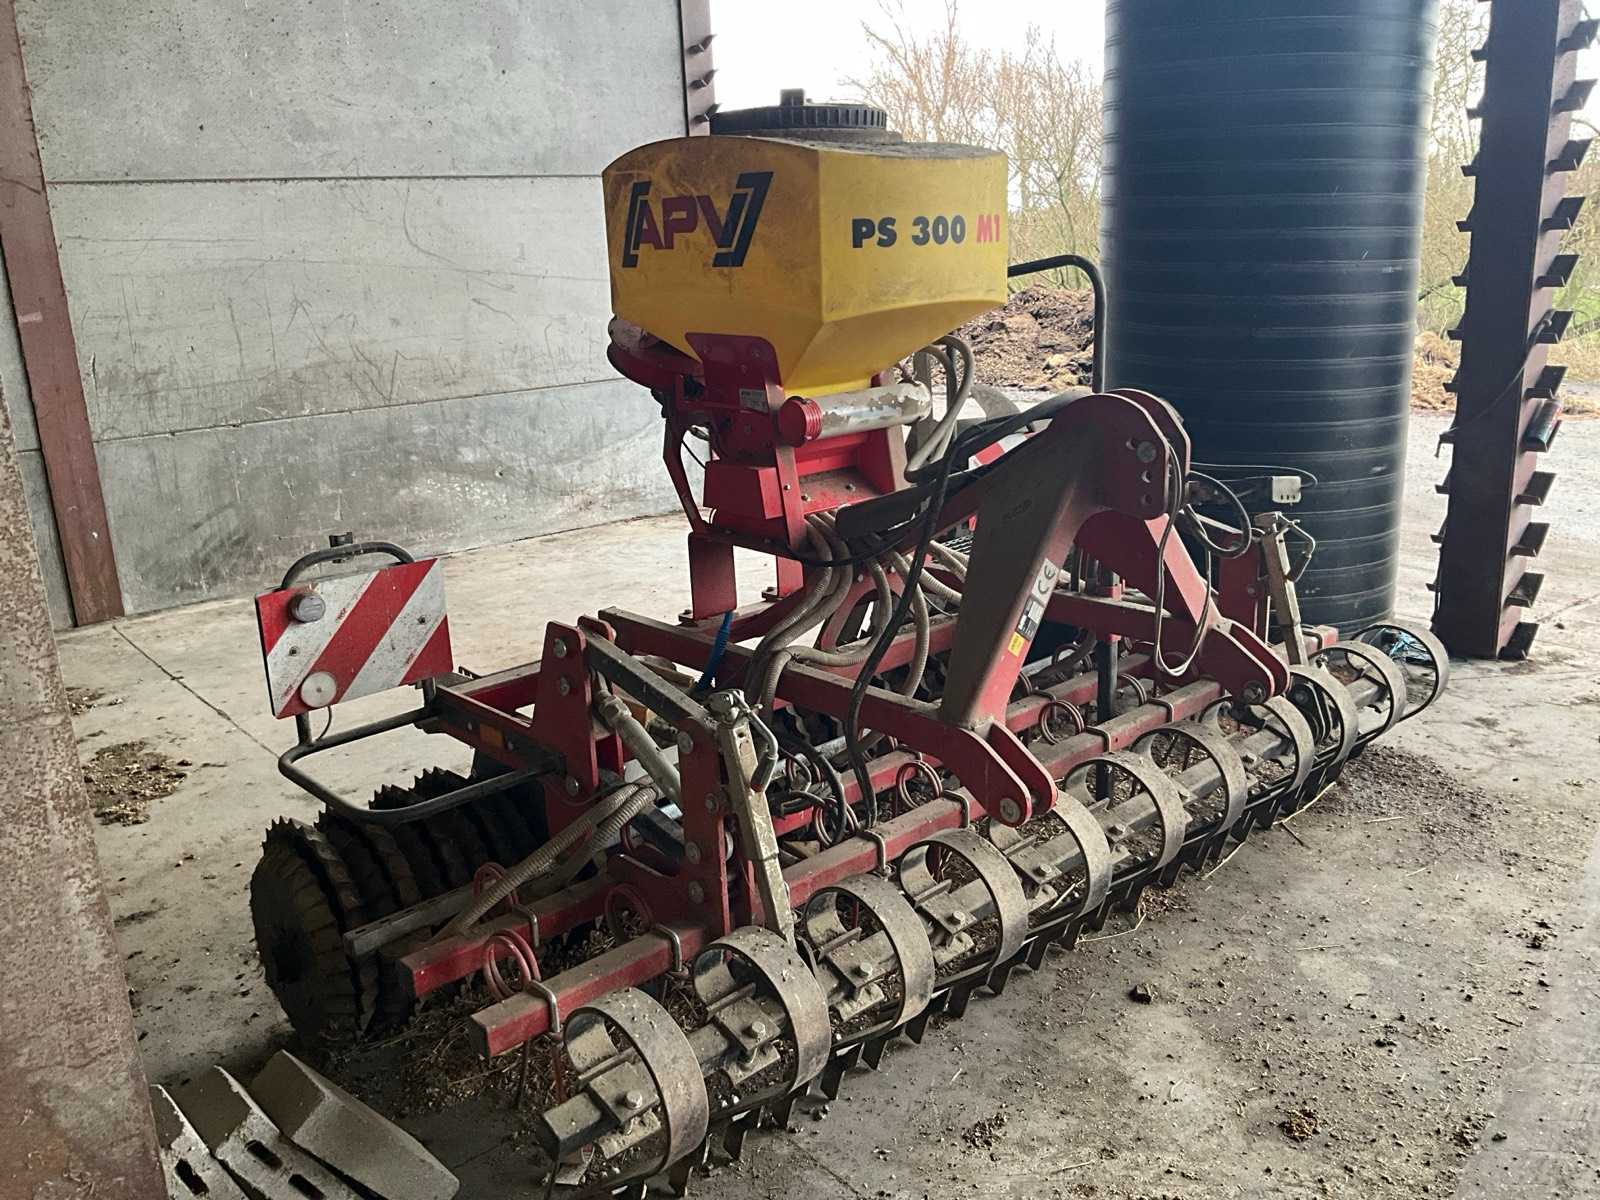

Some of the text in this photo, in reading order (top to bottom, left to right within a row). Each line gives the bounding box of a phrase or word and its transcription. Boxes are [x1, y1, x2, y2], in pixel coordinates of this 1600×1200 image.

[630, 190, 752, 254] APV
[852, 216, 897, 248] PS
[912, 214, 966, 246] 300
[1037, 564, 1056, 595] CE
